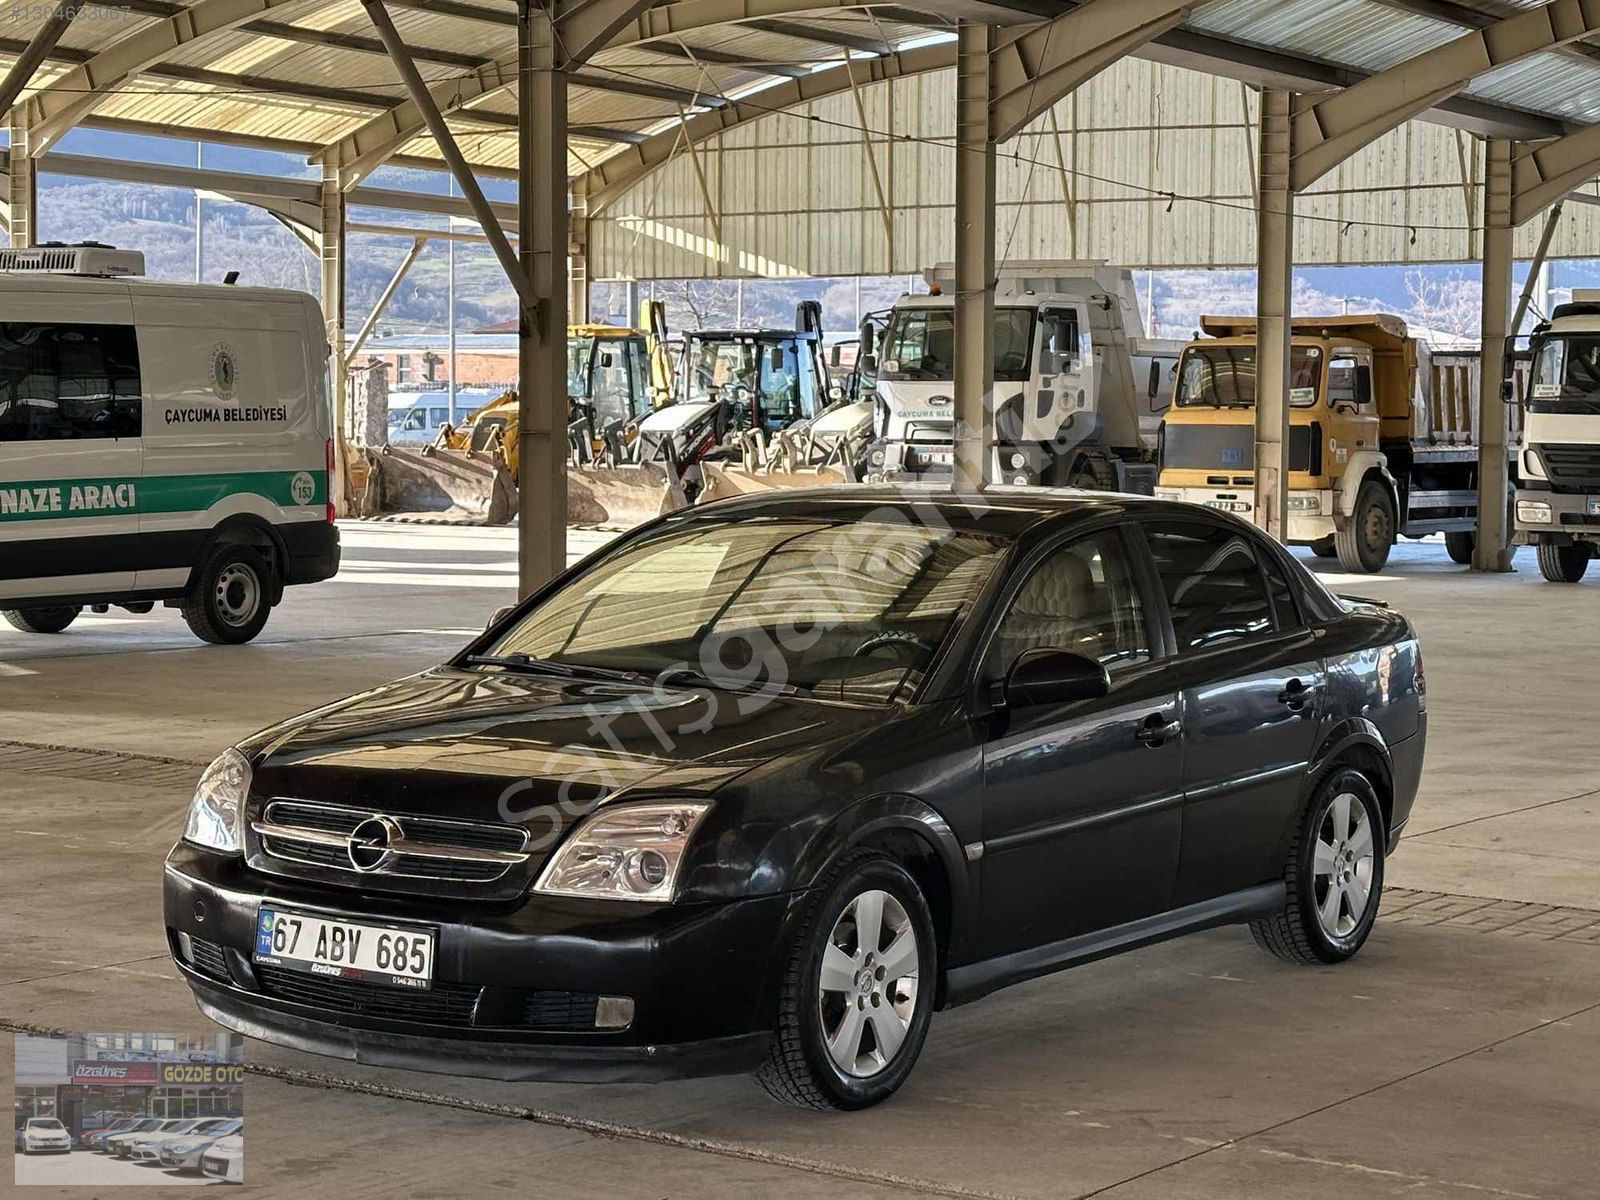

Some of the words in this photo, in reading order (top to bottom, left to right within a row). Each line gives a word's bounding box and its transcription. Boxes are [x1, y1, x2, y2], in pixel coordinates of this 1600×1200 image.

[165, 408, 221, 425] ÇAYCUMA
[223, 404, 287, 422] BELEDİYESİ
[0, 487, 62, 514] NAZE
[68, 483, 136, 510] ARACI
[297, 486, 313, 499] 153
[260, 934, 271, 947] TR
[273, 917, 302, 955] 67
[314, 925, 362, 965] ABV
[375, 933, 427, 975] 685
